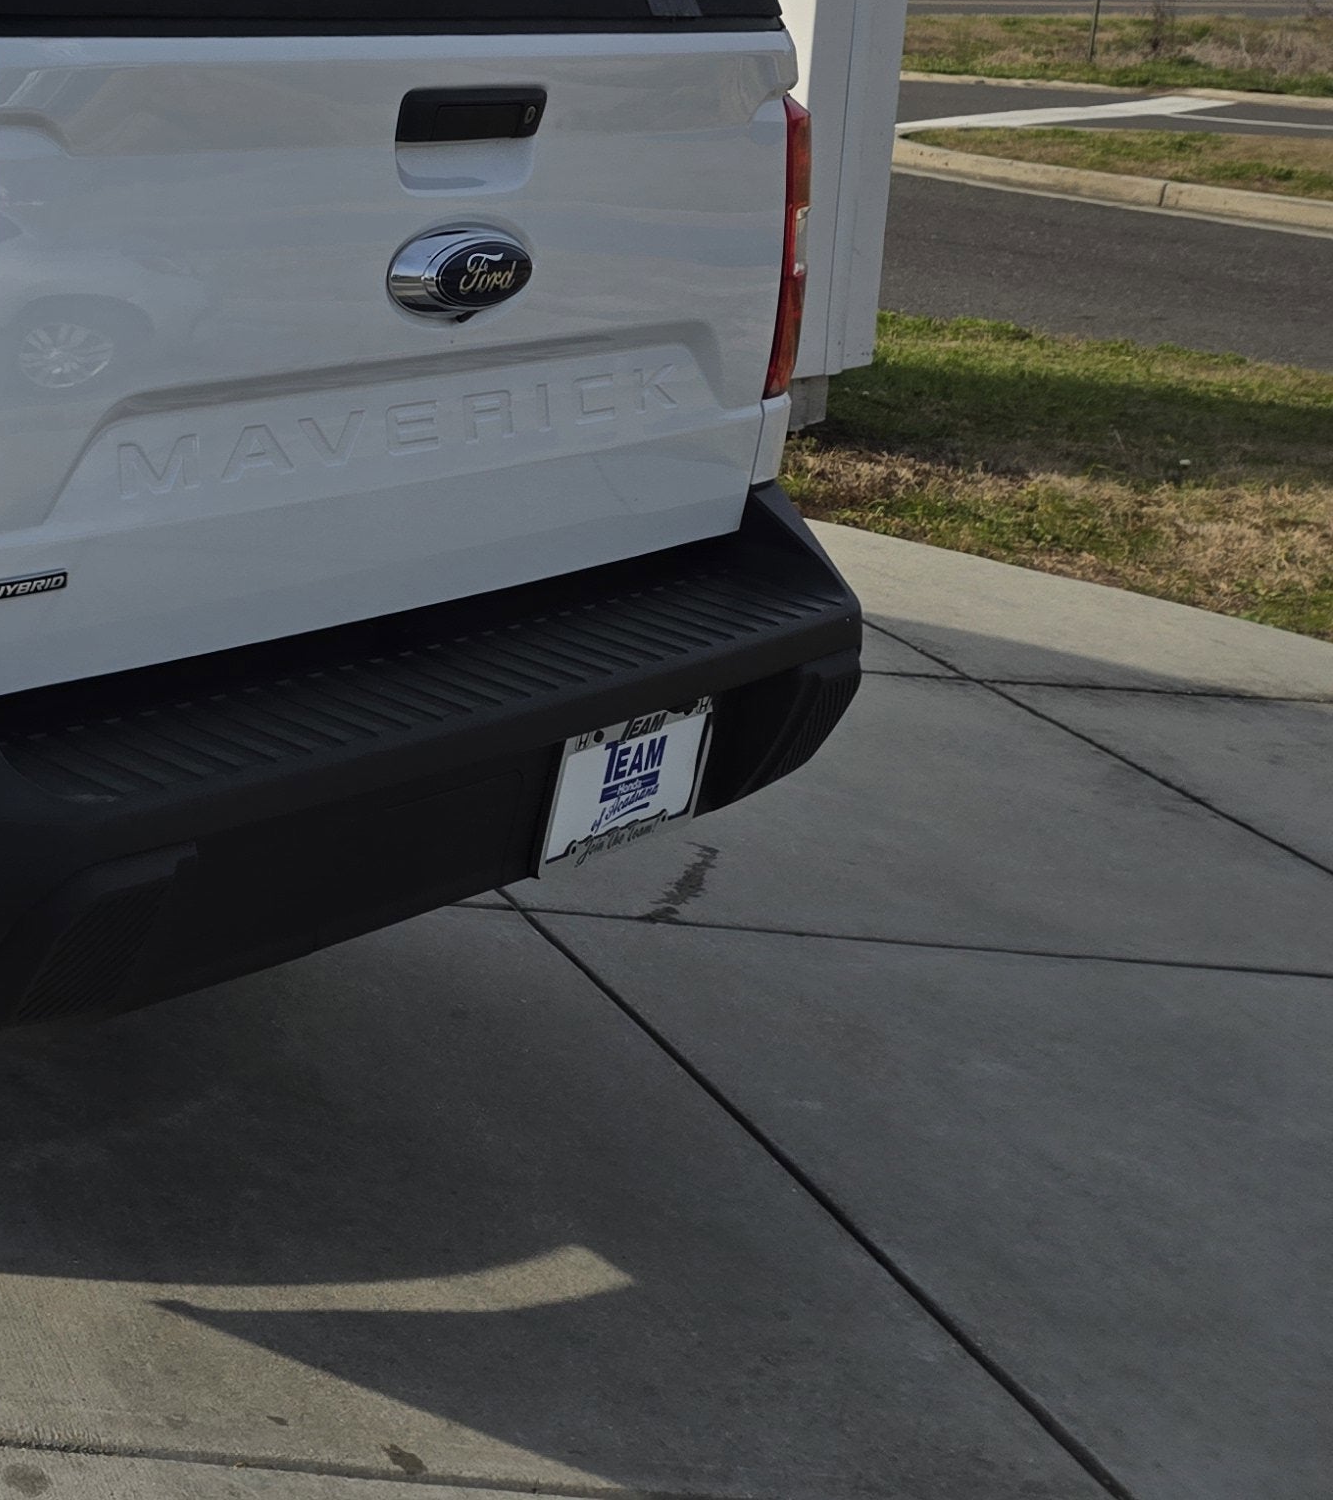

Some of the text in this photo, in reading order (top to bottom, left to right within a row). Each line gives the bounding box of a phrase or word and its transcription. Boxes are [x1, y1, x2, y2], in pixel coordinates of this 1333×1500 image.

[459, 252, 518, 295] Ford
[117, 362, 679, 500] MAVERICK
[603, 735, 668, 785] TEAM
[591, 807, 607, 835] of
